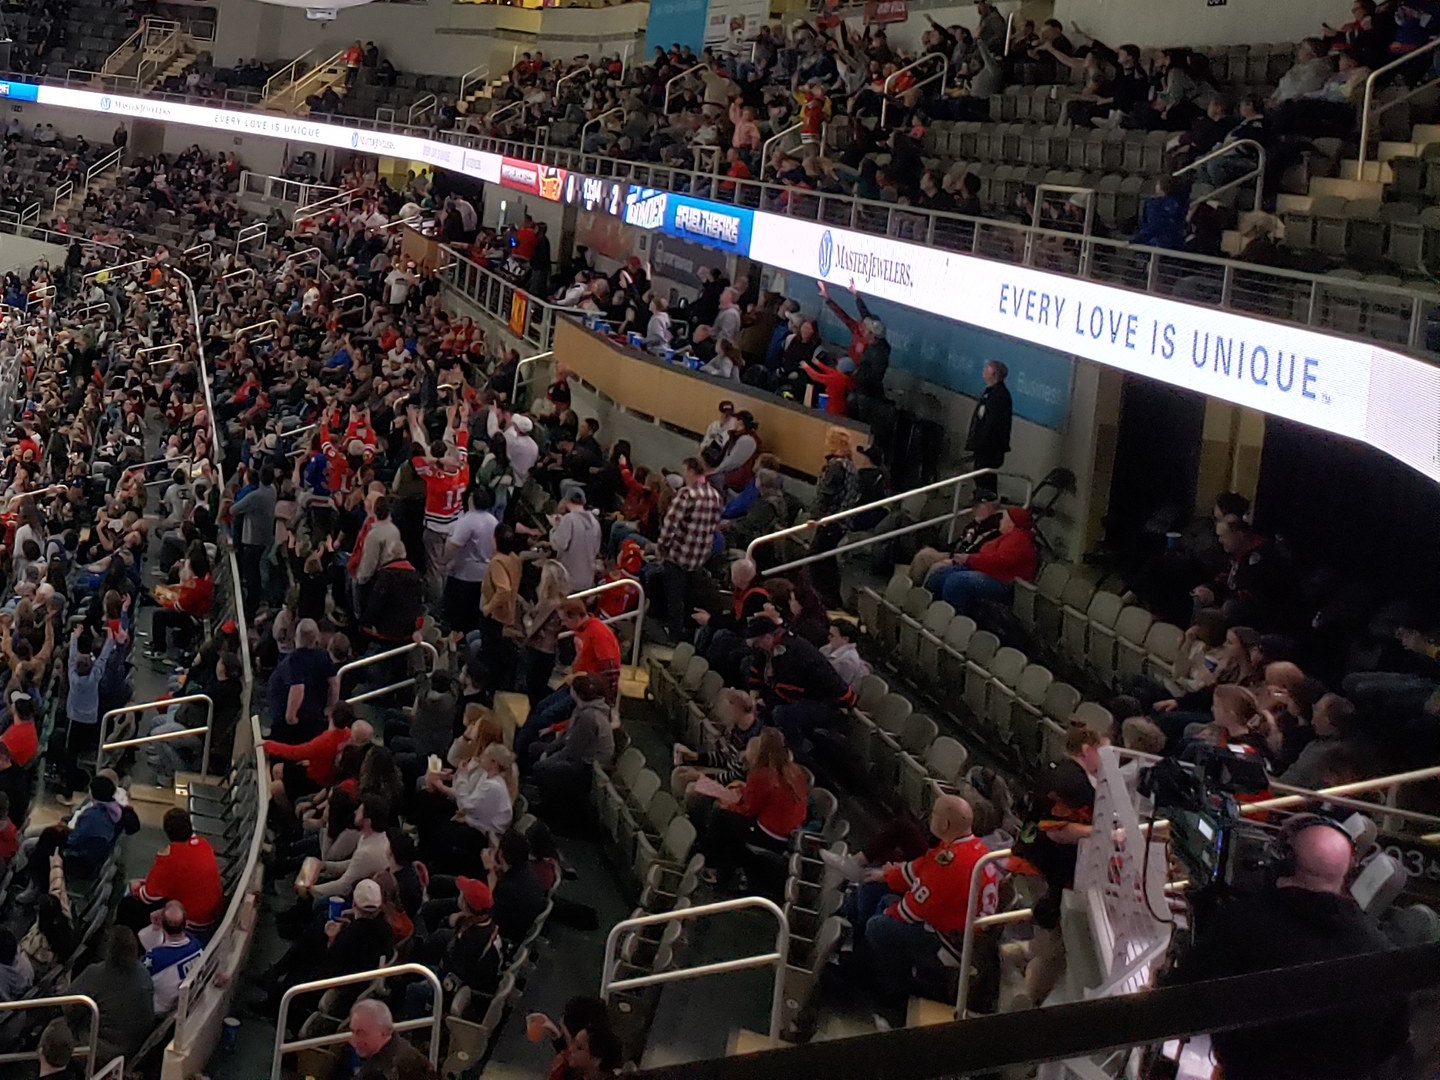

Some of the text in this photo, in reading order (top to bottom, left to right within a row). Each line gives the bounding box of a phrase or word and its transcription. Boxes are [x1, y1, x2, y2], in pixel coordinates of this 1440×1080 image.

[214, 114, 321, 138] EVERY LOVE IS UNIQUE
[998, 282, 1321, 402] EVERY LOVE IS UNIQUE
